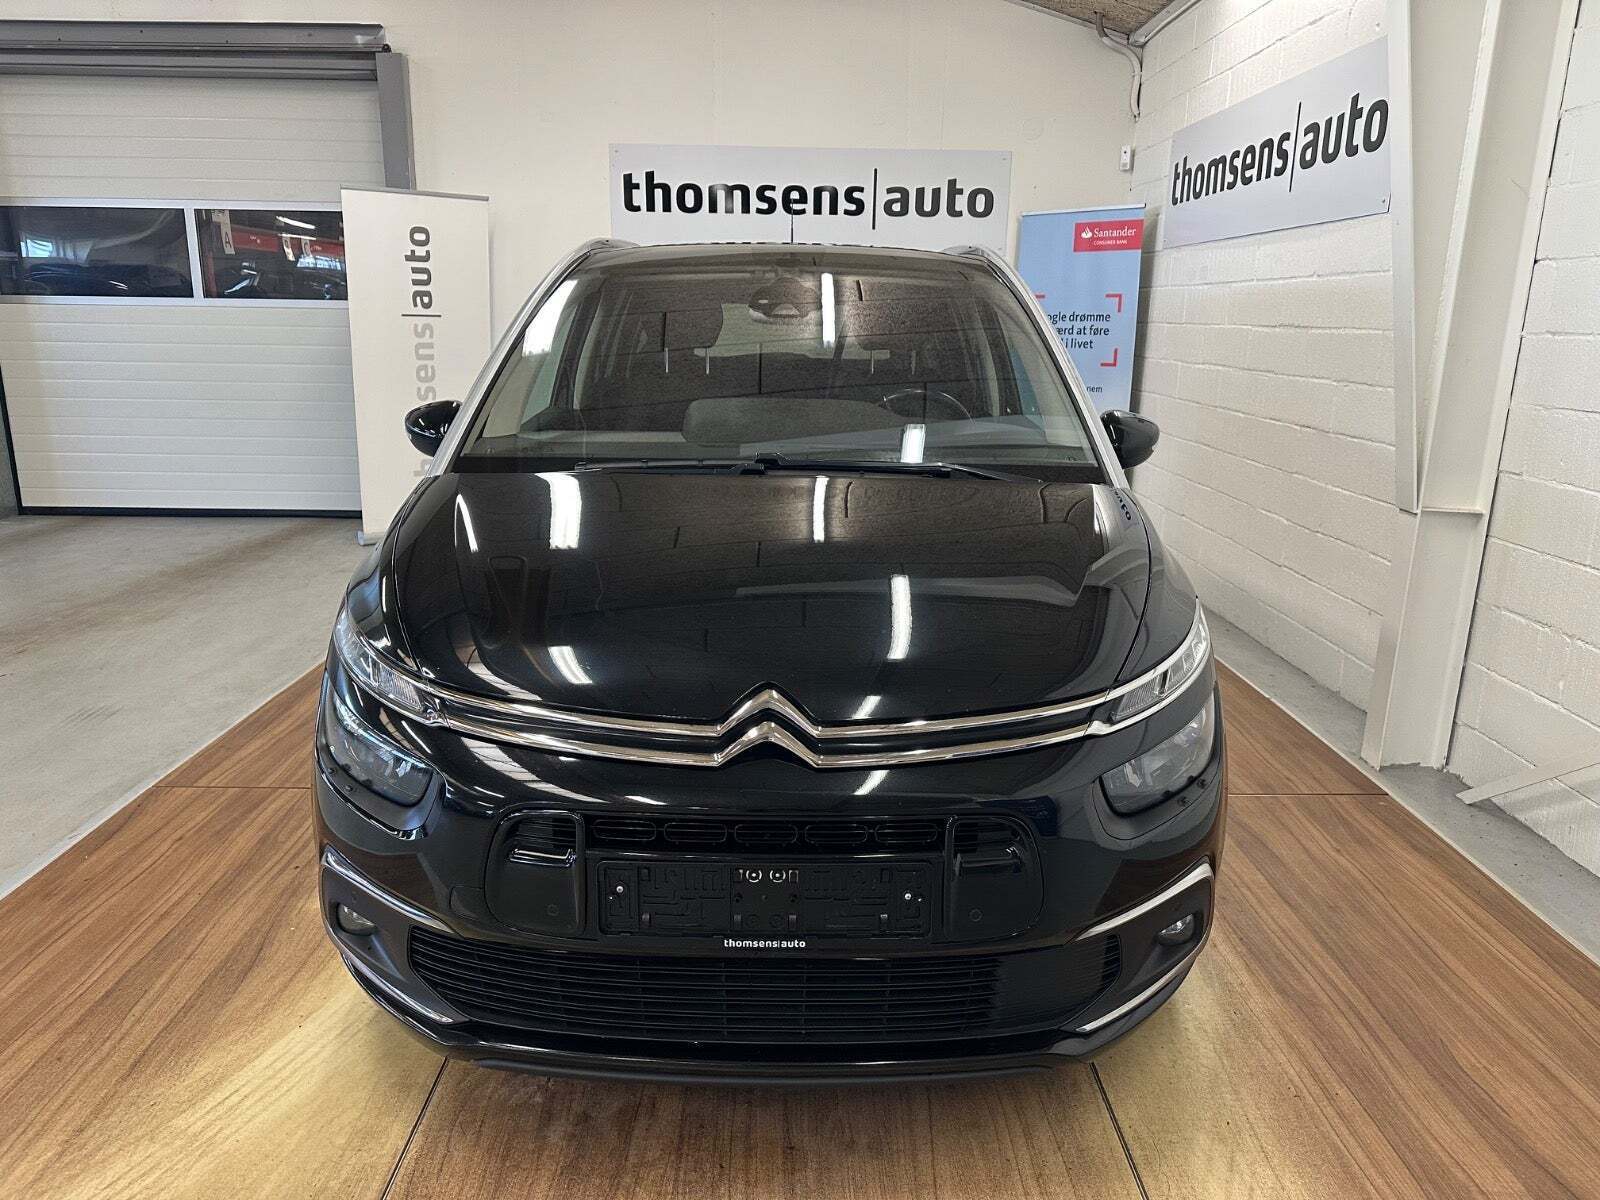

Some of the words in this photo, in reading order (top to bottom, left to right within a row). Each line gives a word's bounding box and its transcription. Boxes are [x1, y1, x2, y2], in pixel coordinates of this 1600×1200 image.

[883, 178, 995, 219] auto
[1093, 226, 1136, 237] Santander
[404, 225, 433, 310] auto
[1068, 311, 1111, 322] drømme
[1076, 328, 1087, 336] at
[1089, 325, 1110, 336] føre
[1070, 338, 1094, 349] livet
